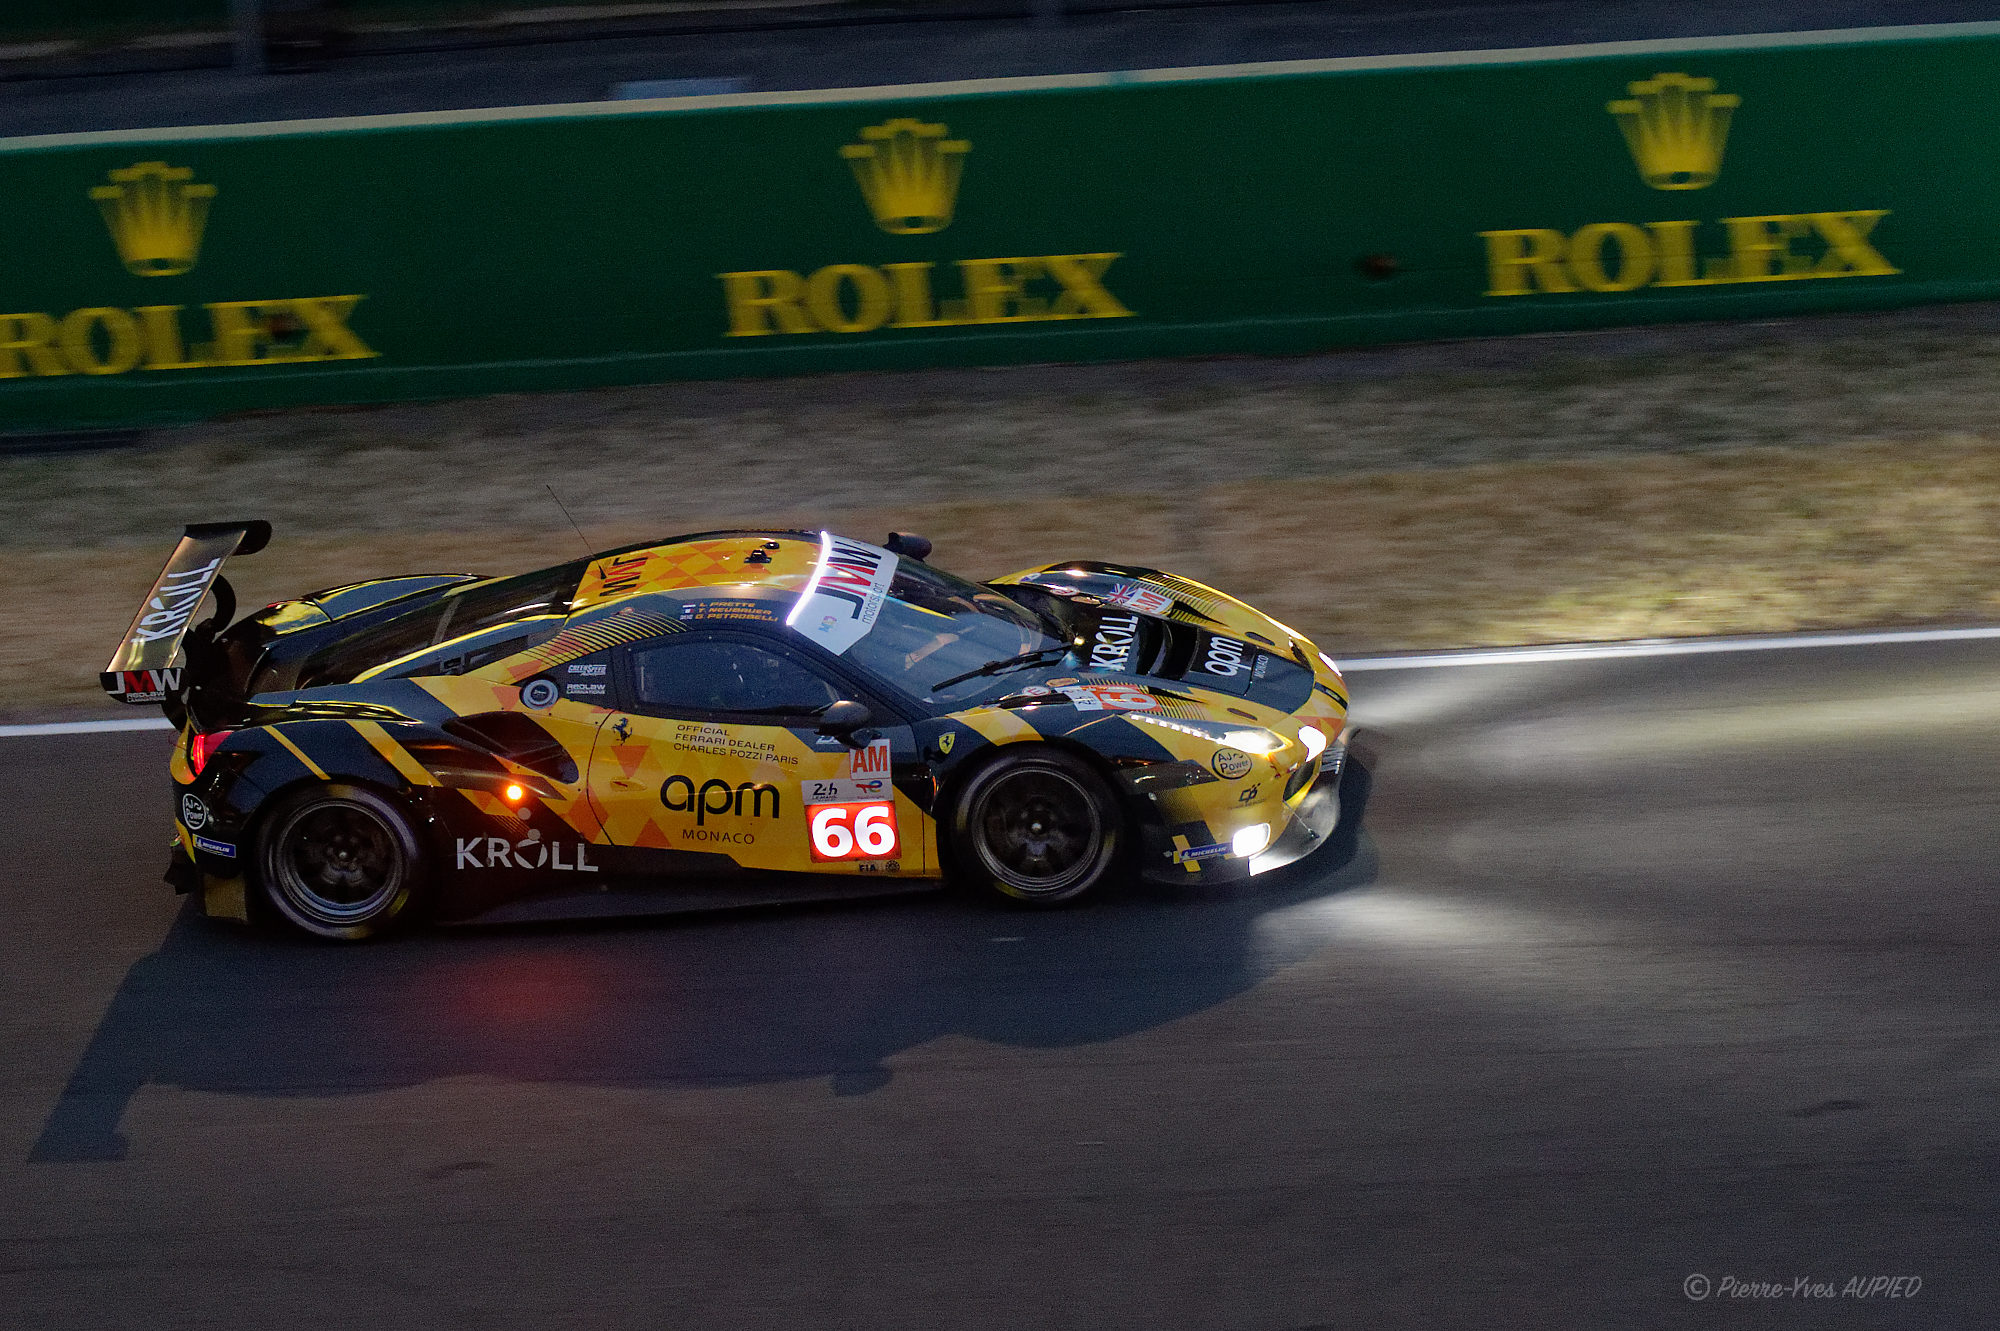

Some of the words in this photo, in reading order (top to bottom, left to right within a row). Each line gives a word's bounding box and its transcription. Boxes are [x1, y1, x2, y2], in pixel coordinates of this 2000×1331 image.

[1476, 208, 1902, 298] ROLEX
[716, 252, 1137, 339] ROLEX
[0, 294, 382, 380] ROLEX
[599, 557, 649, 597] JMW
[814, 541, 882, 620] JMW
[130, 558, 221, 643] KROLL
[1089, 615, 1139, 672] KROLL
[1204, 636, 1252, 677] apm
[106, 668, 182, 695] JMW
[675, 733, 726, 746] FERRARI
[729, 739, 776, 752] DEALER
[677, 724, 730, 737] OFFICIAL
[673, 743, 727, 756] CHARLES
[729, 749, 762, 760] POZZI
[765, 753, 799, 765] PARIS
[852, 745, 888, 773] AM
[660, 774, 780, 826] apm
[456, 831, 599, 872] KROLL
[682, 829, 755, 845] MONACO
[811, 805, 896, 858] 66
[859, 863, 878, 873] FIA
